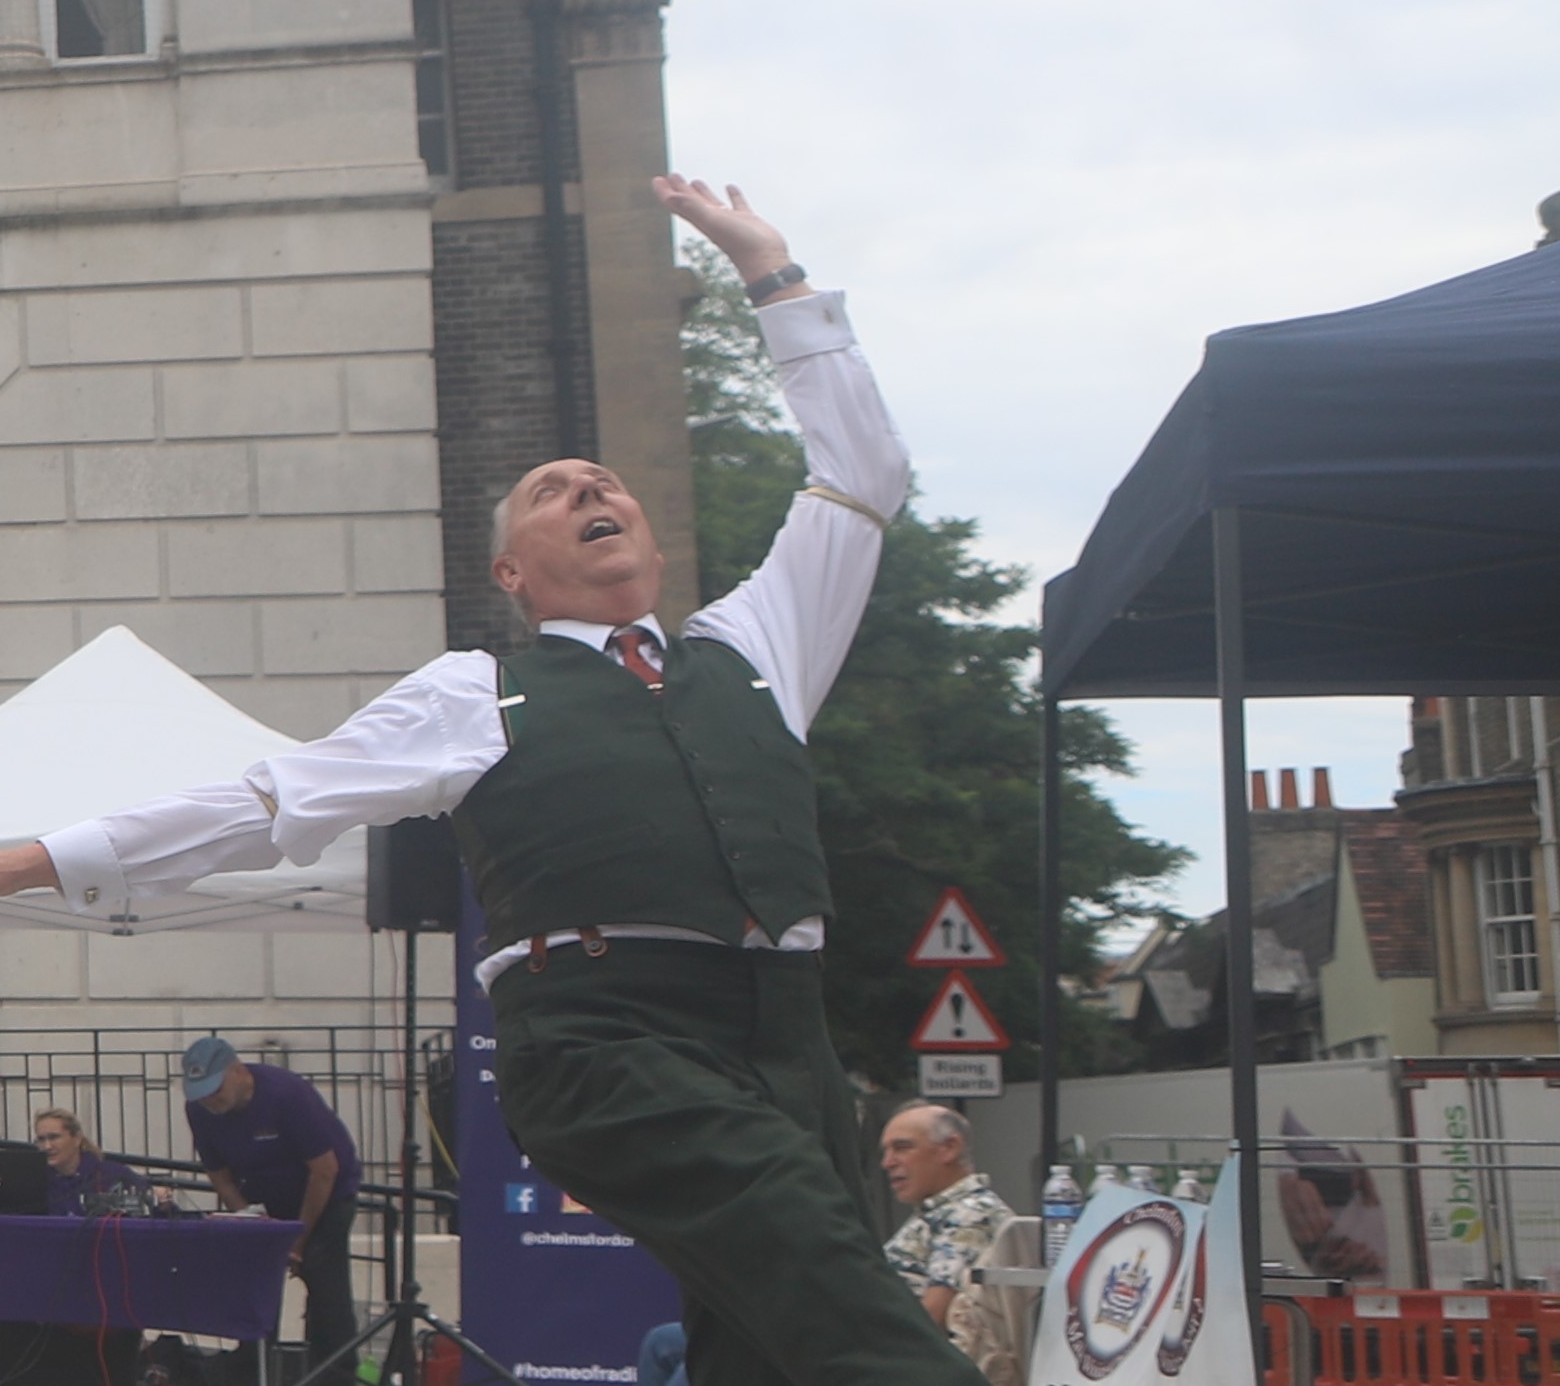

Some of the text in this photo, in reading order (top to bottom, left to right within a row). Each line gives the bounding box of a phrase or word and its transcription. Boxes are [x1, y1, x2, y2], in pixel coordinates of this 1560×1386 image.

[935, 1061, 987, 1076] Rising
[929, 1077, 994, 1089] bollards
[1442, 1105, 1474, 1203] brakes
